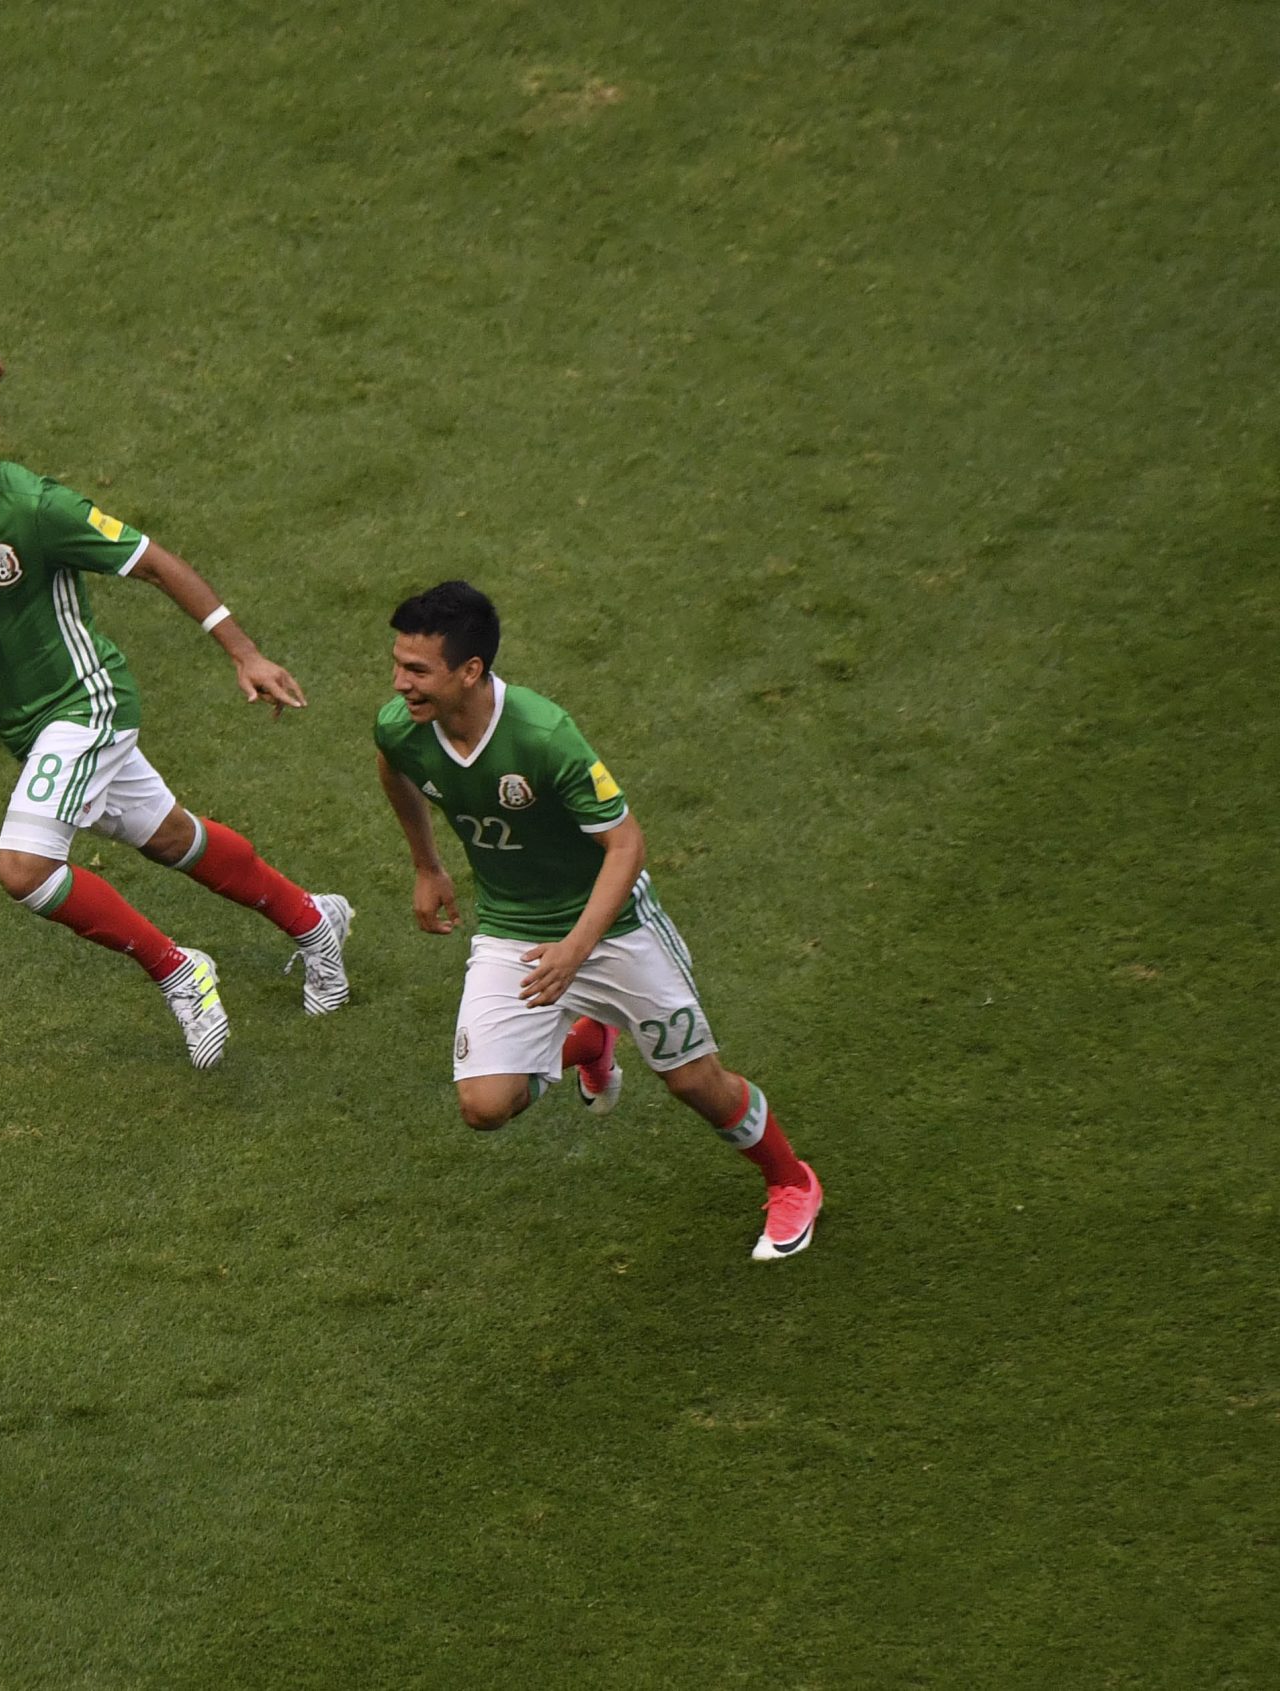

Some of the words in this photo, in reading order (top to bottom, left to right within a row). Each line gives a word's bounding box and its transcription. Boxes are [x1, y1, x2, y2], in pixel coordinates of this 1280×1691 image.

[27, 753, 63, 802] 8
[455, 814, 524, 850] 22
[639, 1007, 705, 1060] 22
